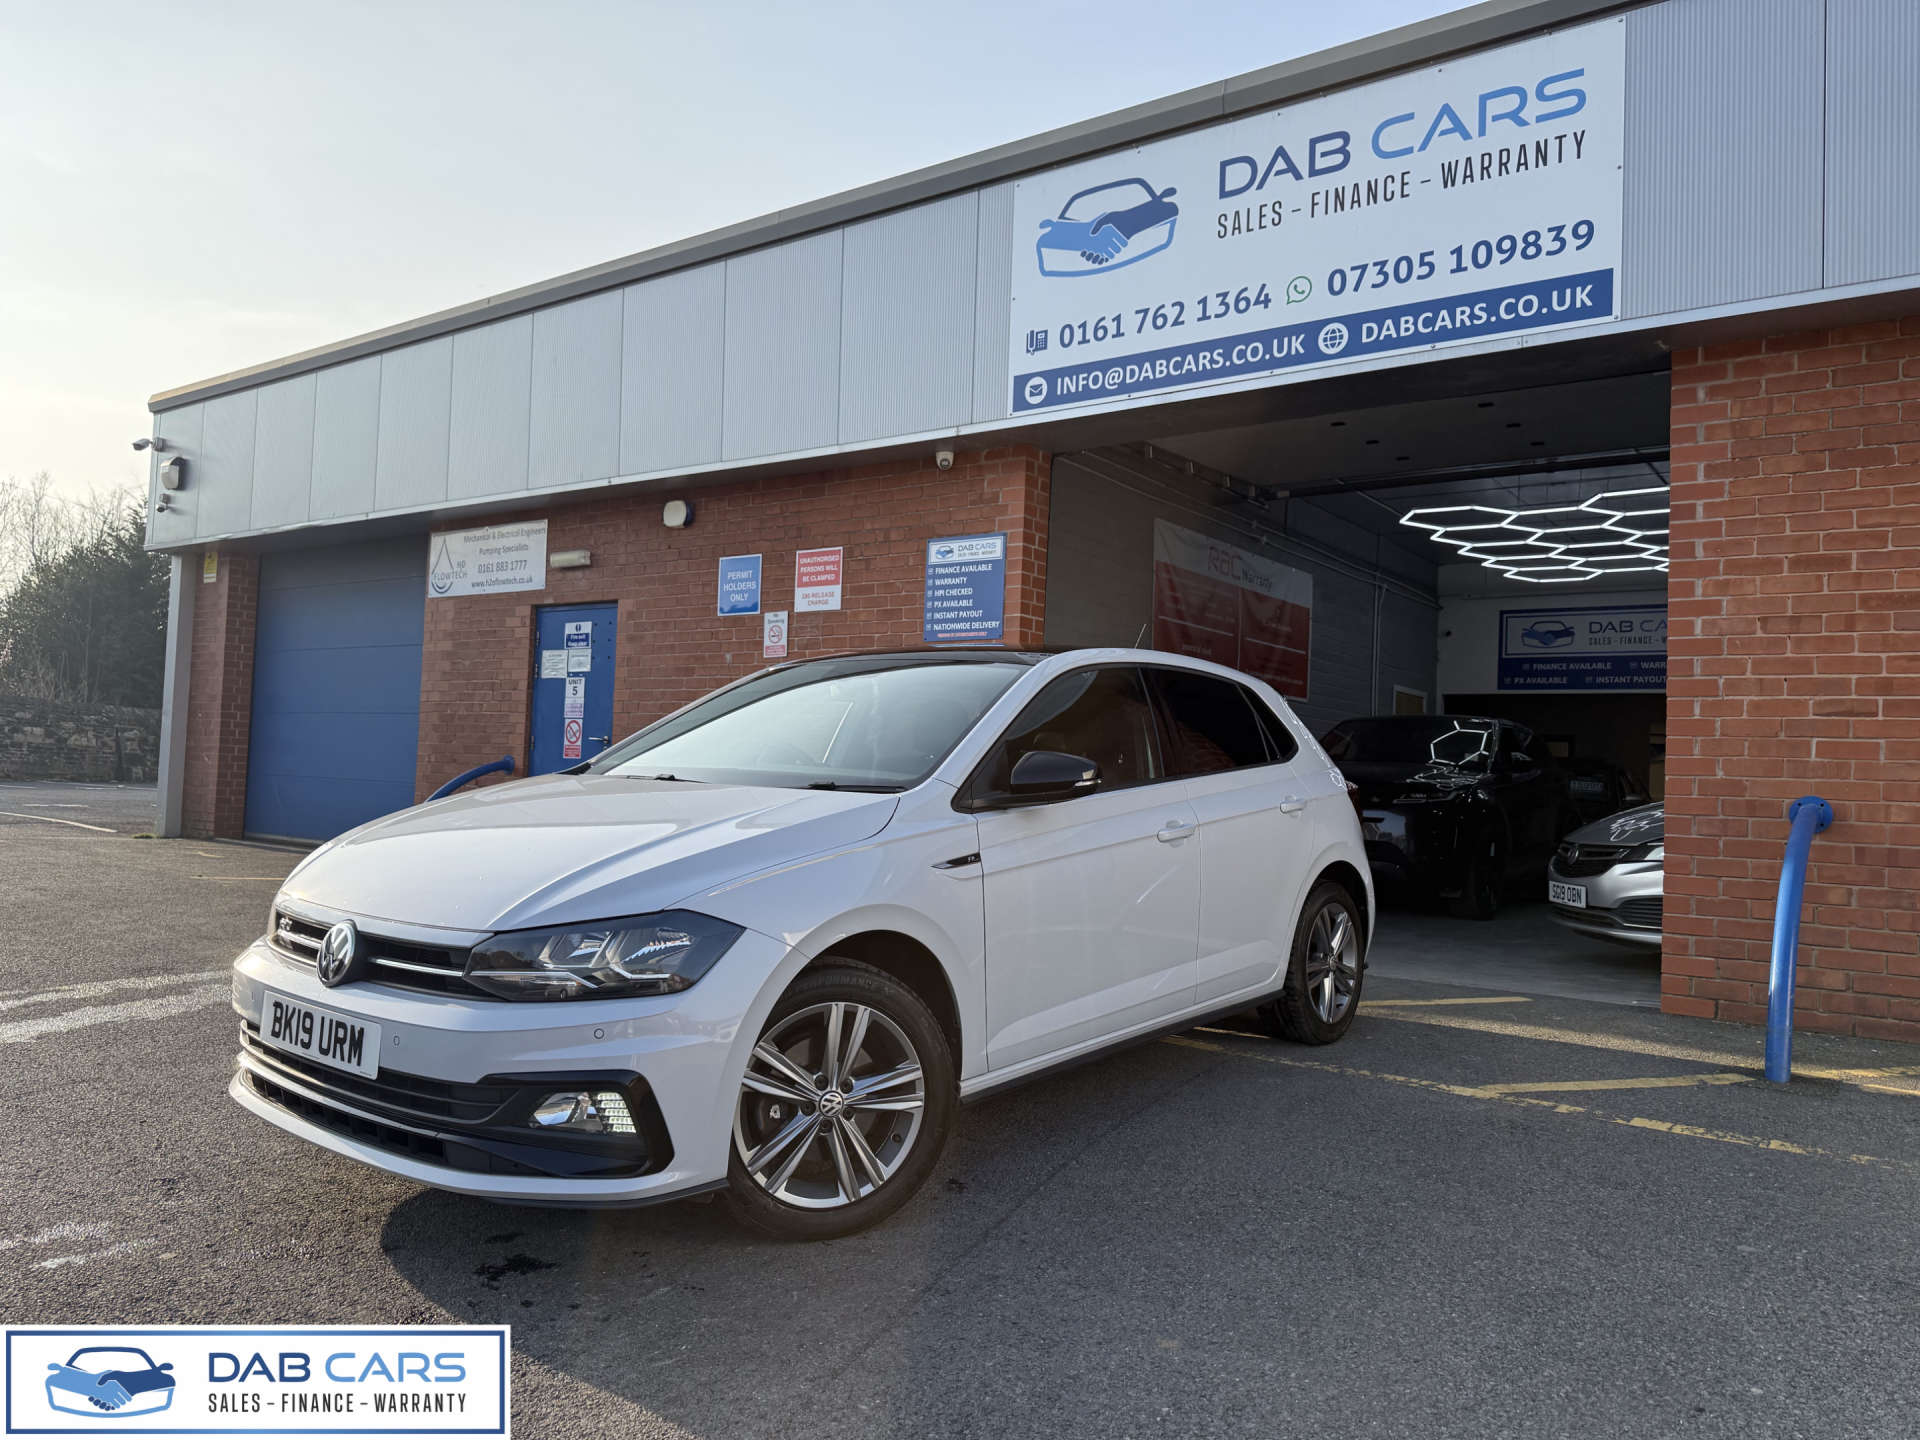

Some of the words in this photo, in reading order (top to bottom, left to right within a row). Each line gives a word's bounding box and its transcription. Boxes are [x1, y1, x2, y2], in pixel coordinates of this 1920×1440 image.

[1219, 131, 1351, 199] DAB
[1371, 68, 1586, 159] CARS
[1217, 200, 1283, 239] SALES
[1310, 171, 1411, 218] FINANCE
[1441, 130, 1586, 189] WARRANTY
[1059, 313, 1125, 348] 0161
[1135, 301, 1185, 334] 762
[1196, 283, 1272, 322] 1364
[1327, 250, 1436, 296] 07305
[1450, 219, 1595, 274] 109839
[1056, 334, 1305, 396] INFO@DABCARS.CO.UK
[1361, 284, 1593, 343] DABCARS.CO.UK
[957, 544, 974, 552] DAB
[974, 542, 997, 551] CARS
[478, 562, 494, 574] 0161
[510, 559, 528, 572] 1777
[935, 565, 960, 575] FINANCE
[961, 563, 993, 573] AVAILABLE
[727, 570, 753, 580] PERMIT
[723, 581, 757, 592] HOLDERS
[934, 576, 968, 586] WARRANTY
[730, 592, 749, 602] ONLY
[945, 587, 973, 597] CHECKED
[934, 600, 943, 608] PX
[943, 598, 974, 608] AVAILABLE
[933, 611, 958, 620] INSTANT
[959, 609, 983, 618] PAYOUT
[933, 621, 972, 631] NATIONWIDE
[971, 620, 1001, 630] DELIVERY
[1588, 620, 1634, 634] DAB
[1588, 636, 1612, 646] SALES
[1619, 635, 1652, 646] FINANCE
[1532, 662, 1567, 671] FINANCE
[1568, 661, 1612, 671] AVAILABLE
[1525, 676, 1569, 685] AVAILABLE
[1596, 675, 1633, 684] INSTANT
[572, 686, 578, 696] 5
[271, 1001, 314, 1050] BK19
[318, 1015, 365, 1067] URM
